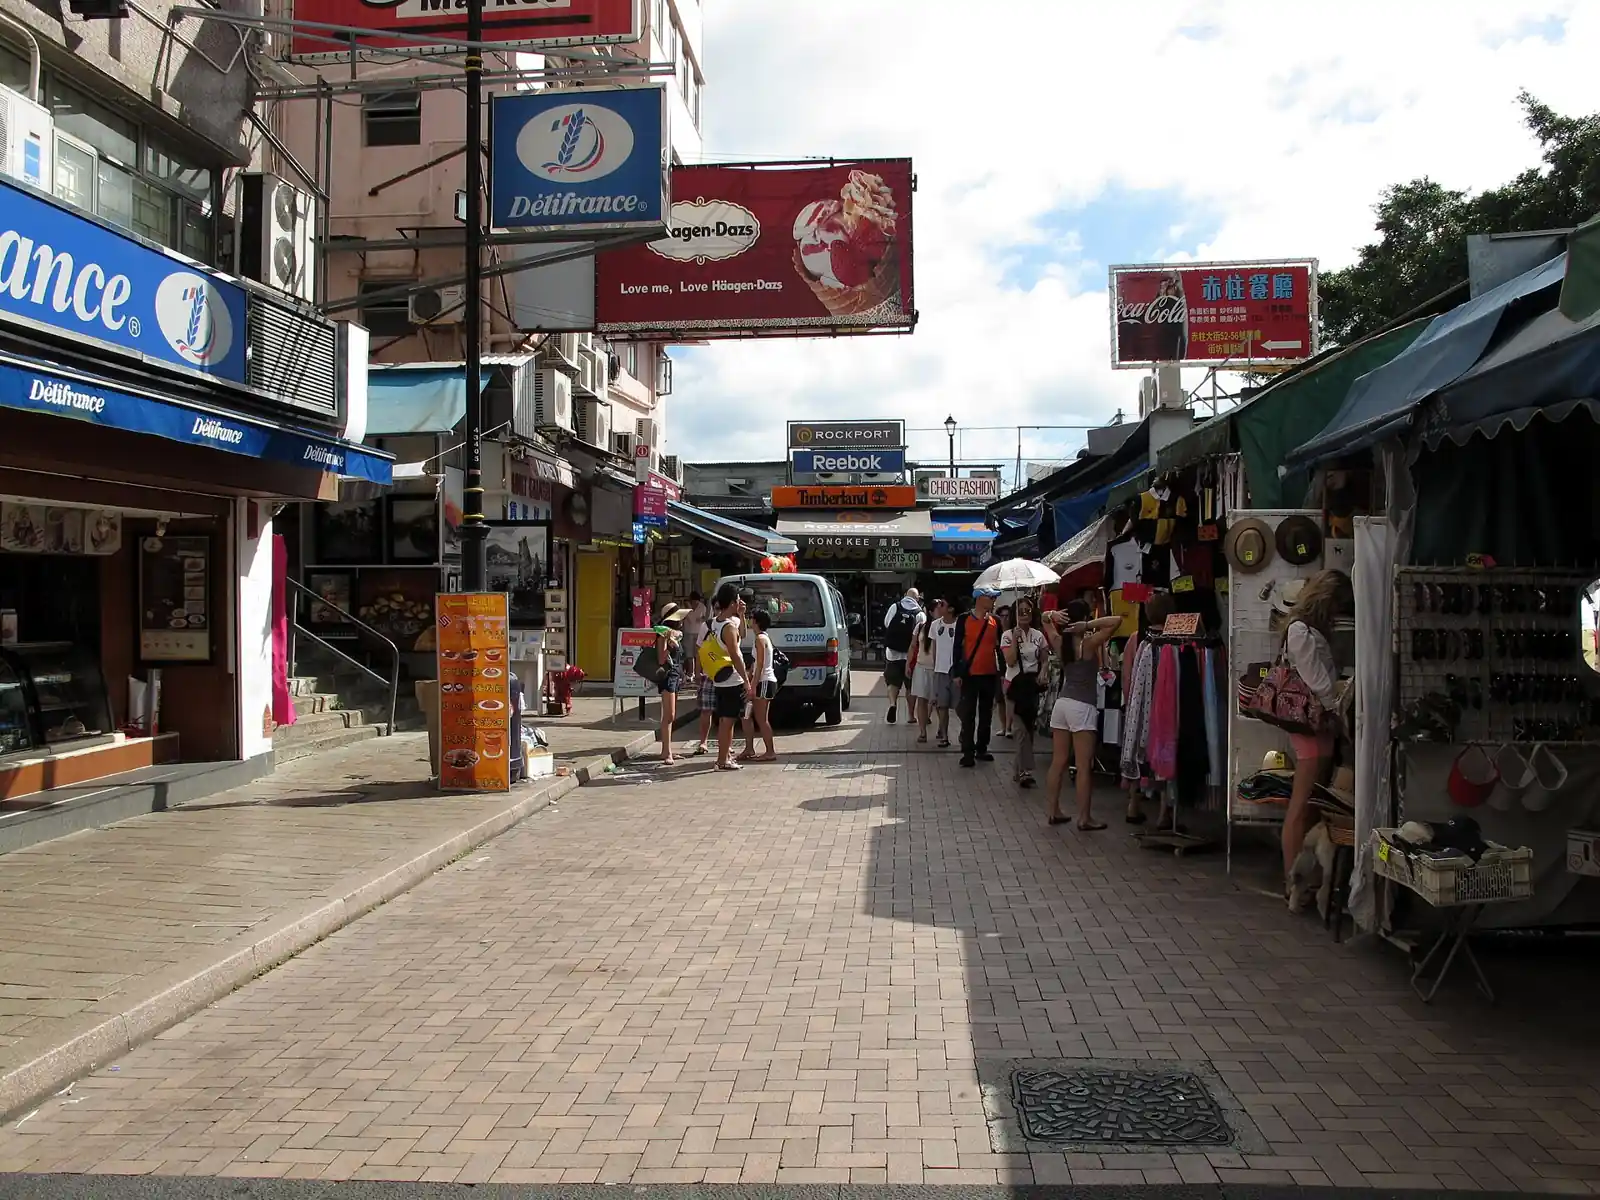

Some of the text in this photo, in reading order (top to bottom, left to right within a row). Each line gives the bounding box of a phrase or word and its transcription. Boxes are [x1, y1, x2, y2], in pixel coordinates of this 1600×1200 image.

[621, 282, 647, 295] Love
[652, 285, 672, 296] me,
[680, 281, 707, 294] Love
[1202, 273, 1293, 301] 赤柱餐廳
[815, 430, 891, 440] ROCKPORT
[812, 454, 882, 471] Reebok
[959, 480, 996, 495] FASHION
[797, 489, 868, 505] Timberland
[808, 537, 870, 547] KONG KEE
[877, 553, 906, 563] SPORTS
[802, 668, 824, 682] 291
